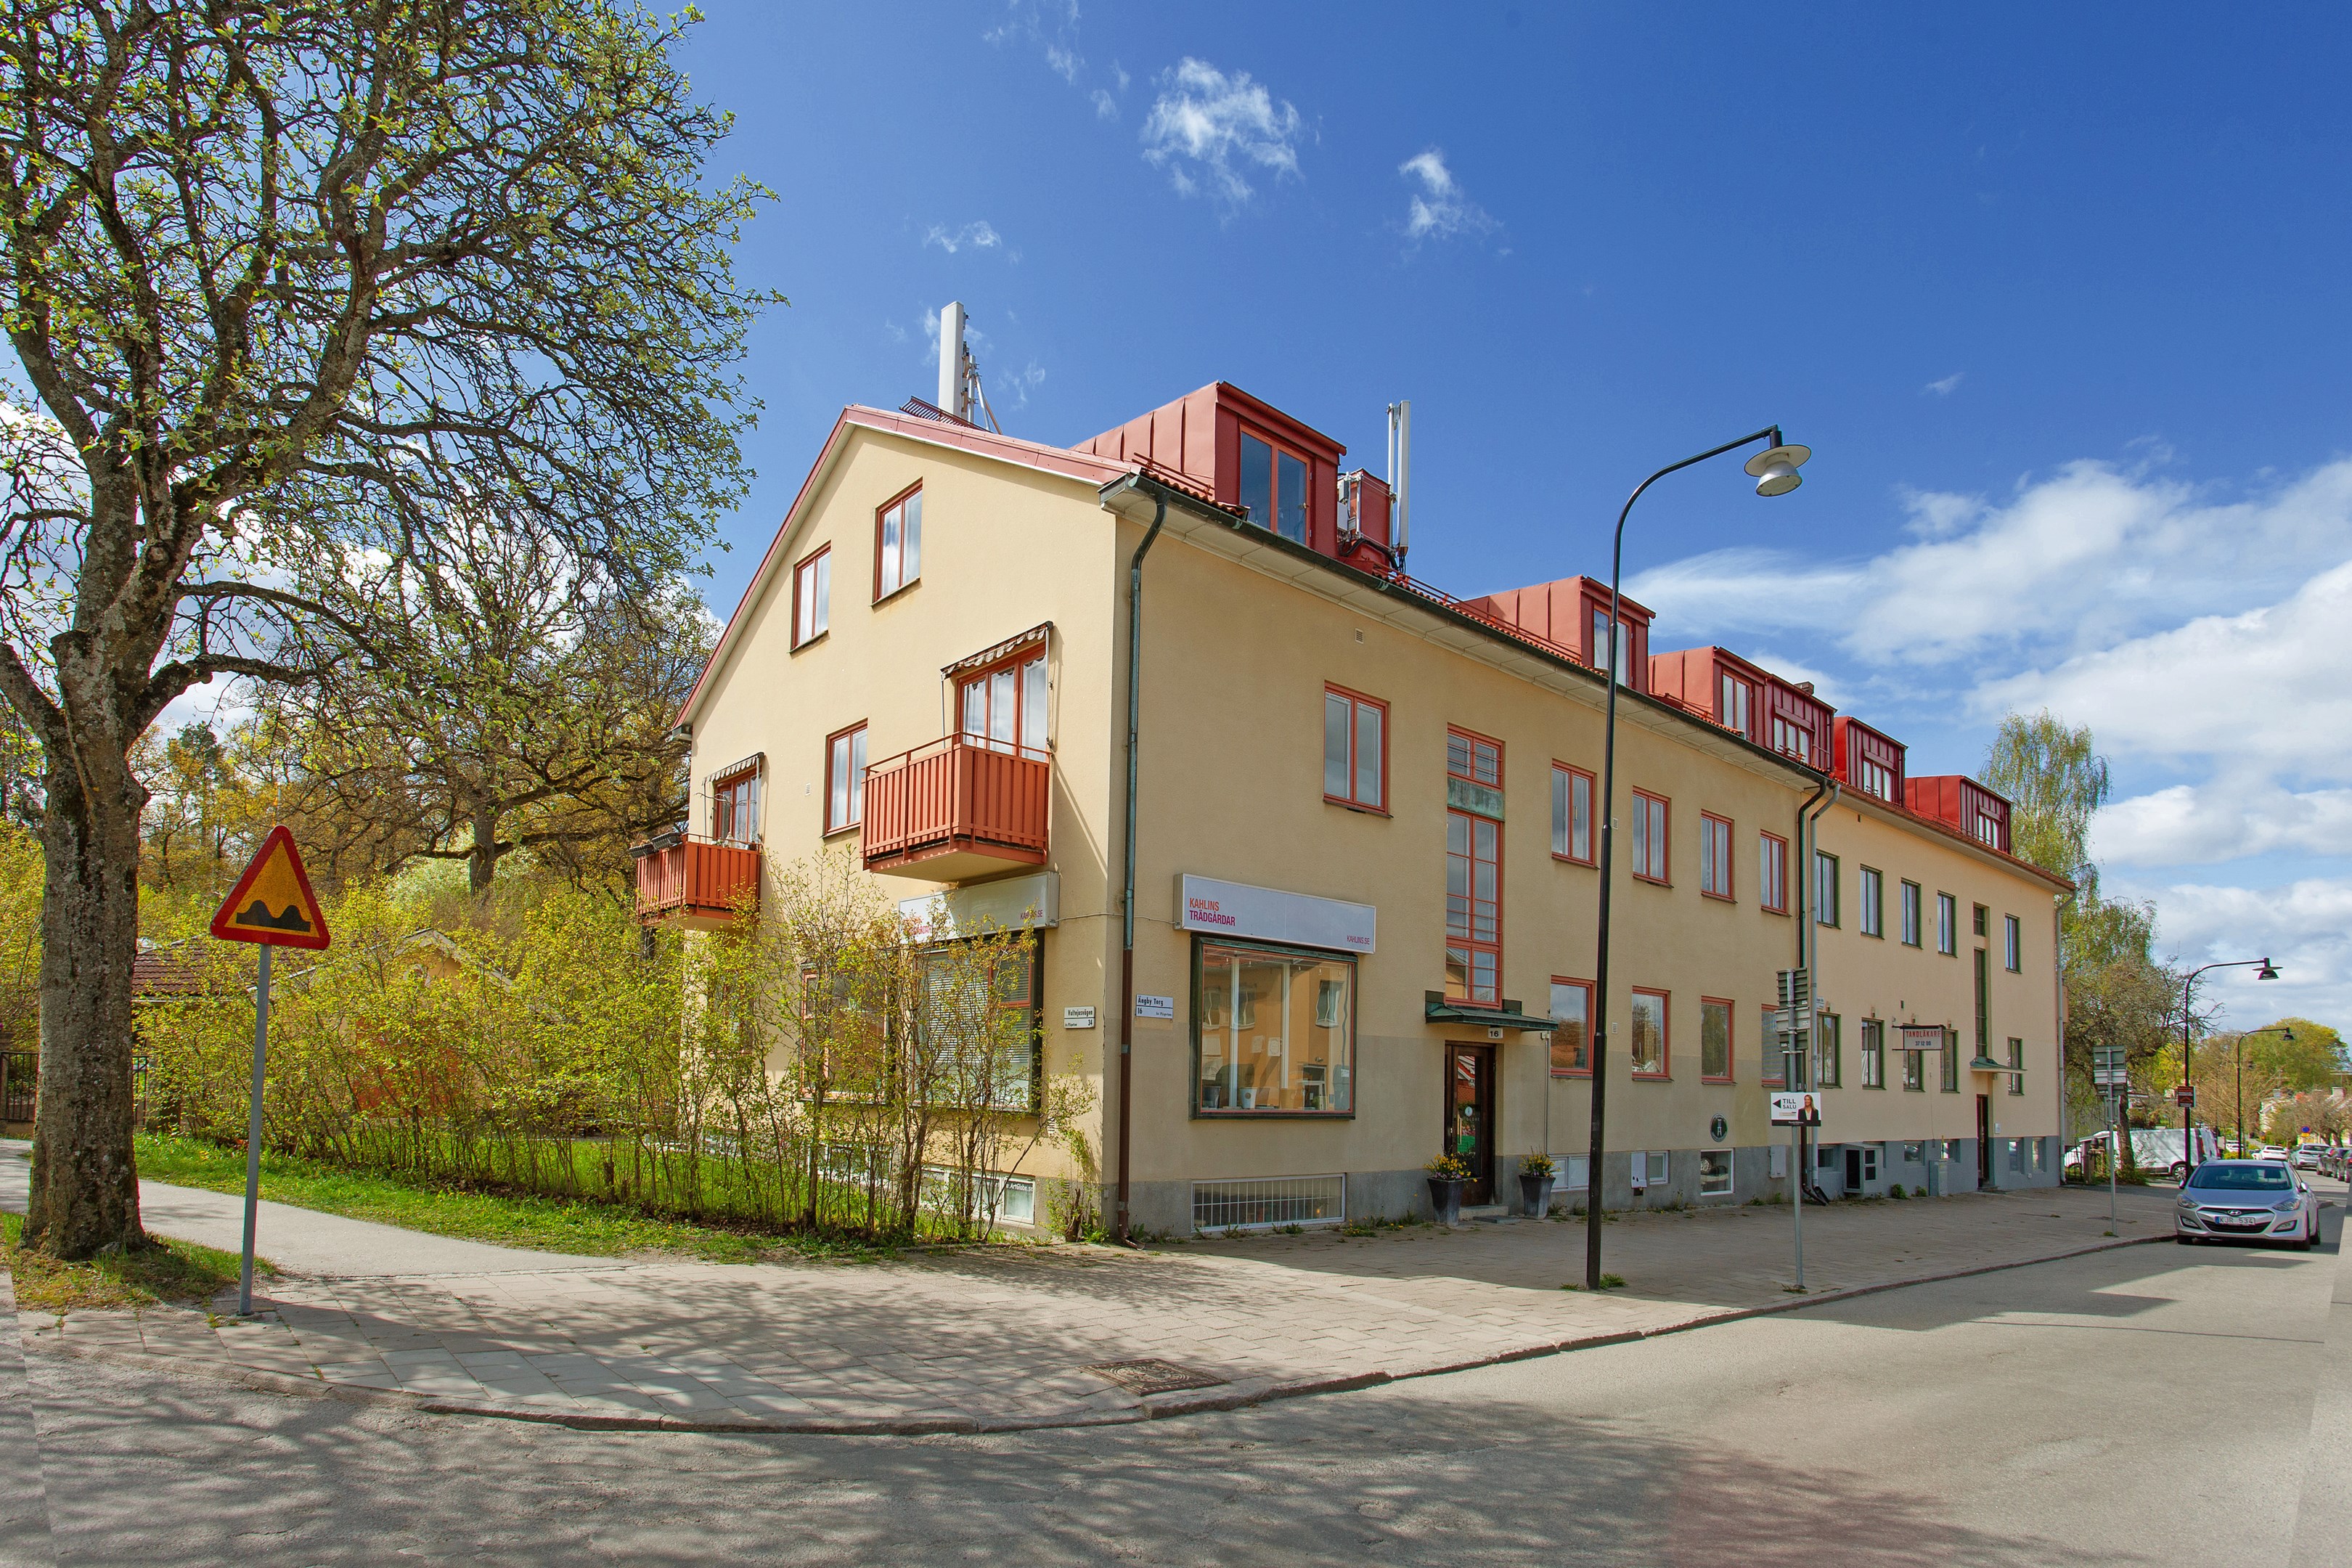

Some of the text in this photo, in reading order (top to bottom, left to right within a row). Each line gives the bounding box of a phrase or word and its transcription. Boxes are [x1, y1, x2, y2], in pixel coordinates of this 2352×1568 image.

[1189, 897, 1220, 912] KAHLINS
[1189, 909, 1236, 926] TRÄDGÅRDAR
[1347, 935, 1370, 945] KAHLINS.SE
[1138, 995, 1164, 1007] Ängby Torg
[1906, 1029, 1941, 1038] TANDLÄKARE
